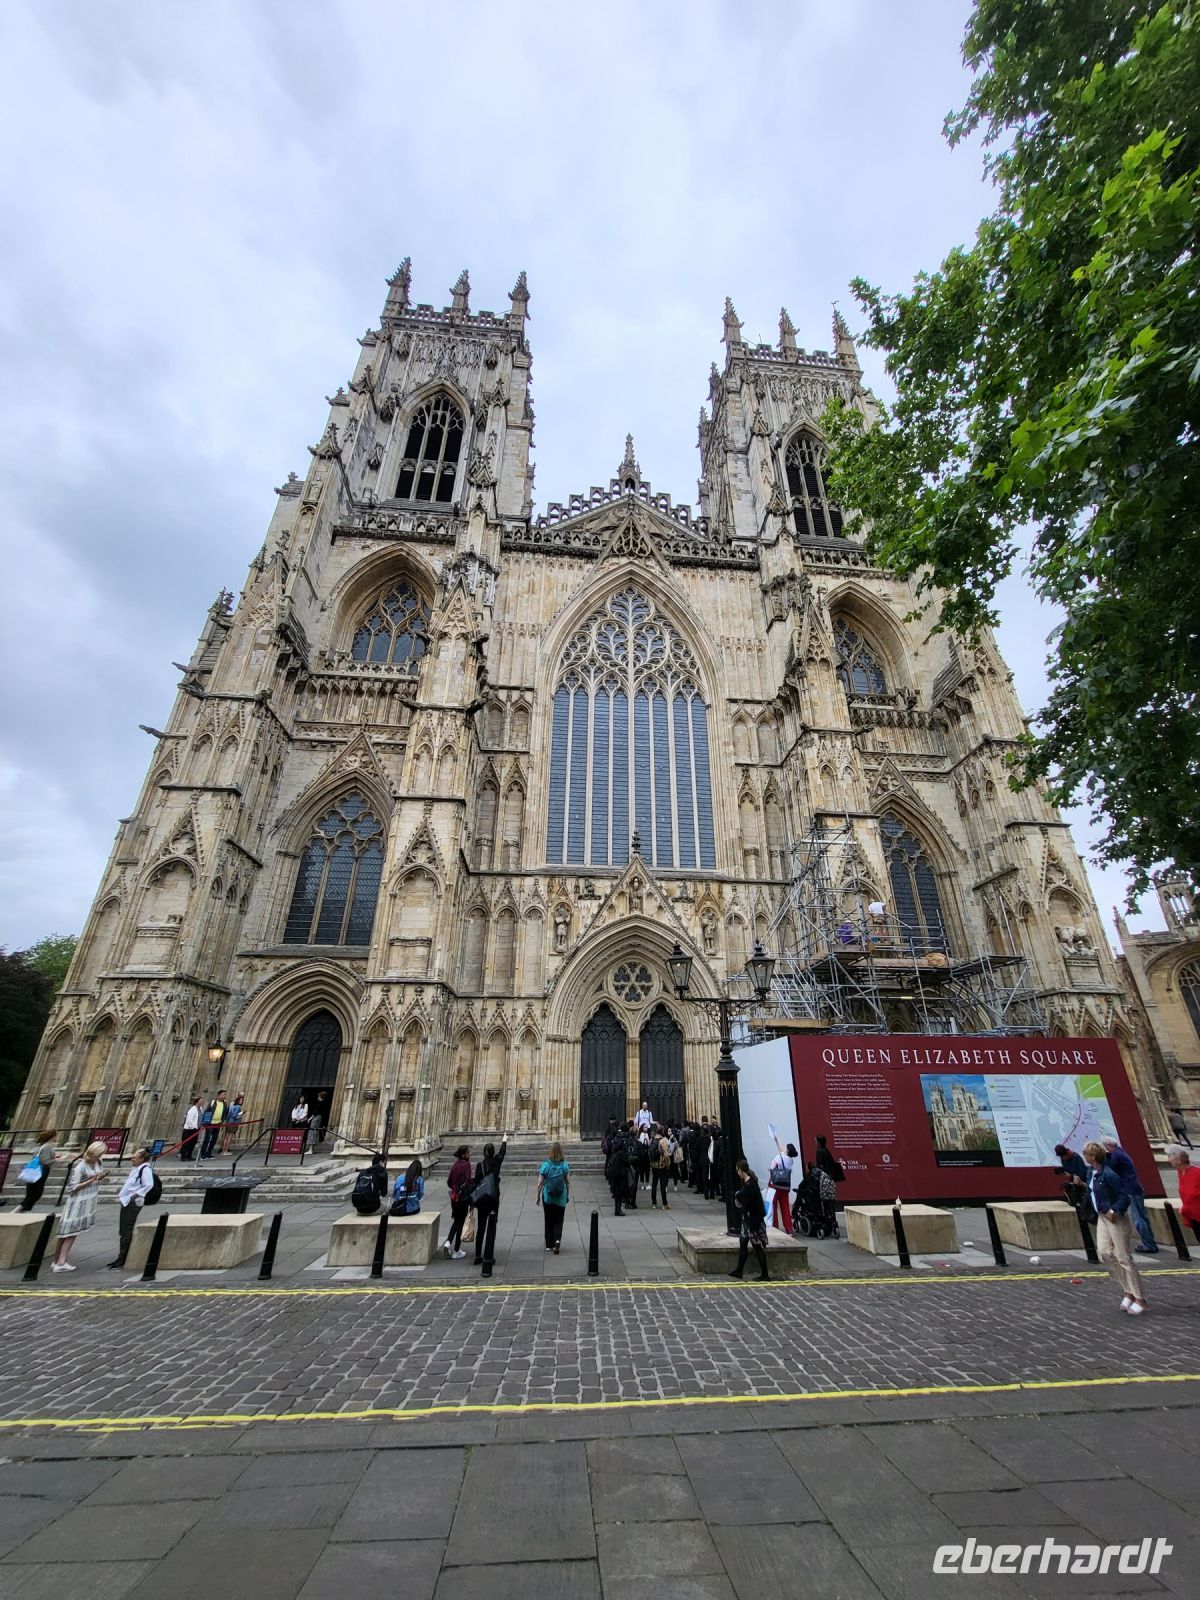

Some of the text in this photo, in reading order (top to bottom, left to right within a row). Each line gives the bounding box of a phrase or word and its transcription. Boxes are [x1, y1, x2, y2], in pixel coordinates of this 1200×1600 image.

[822, 1048, 1097, 1068] QUEEN ELIZABETH SQUARE
